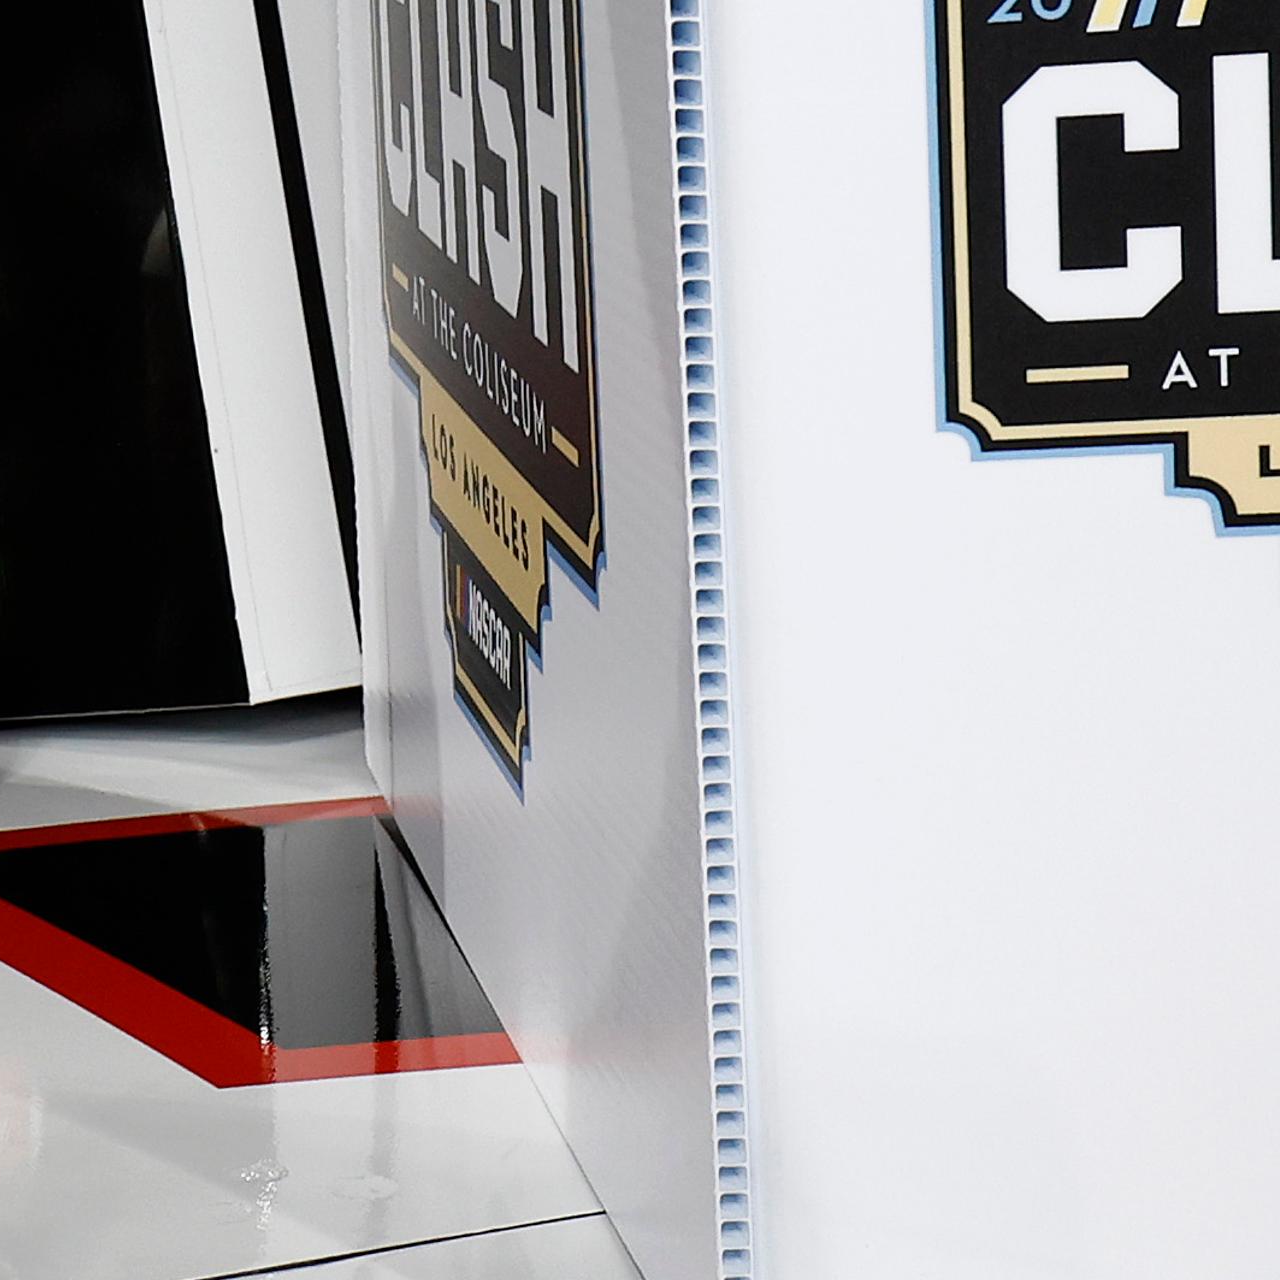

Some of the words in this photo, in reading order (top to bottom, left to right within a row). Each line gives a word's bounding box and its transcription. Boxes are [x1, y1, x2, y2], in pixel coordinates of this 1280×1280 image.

[412, 276, 425, 325] AT
[431, 288, 458, 360] THE
[462, 322, 547, 454] COLISEUM
[1161, 346, 1241, 390] AT
[432, 414, 456, 481] LOS
[463, 452, 529, 572] ANGELES
[468, 579, 511, 690] NASCAR
